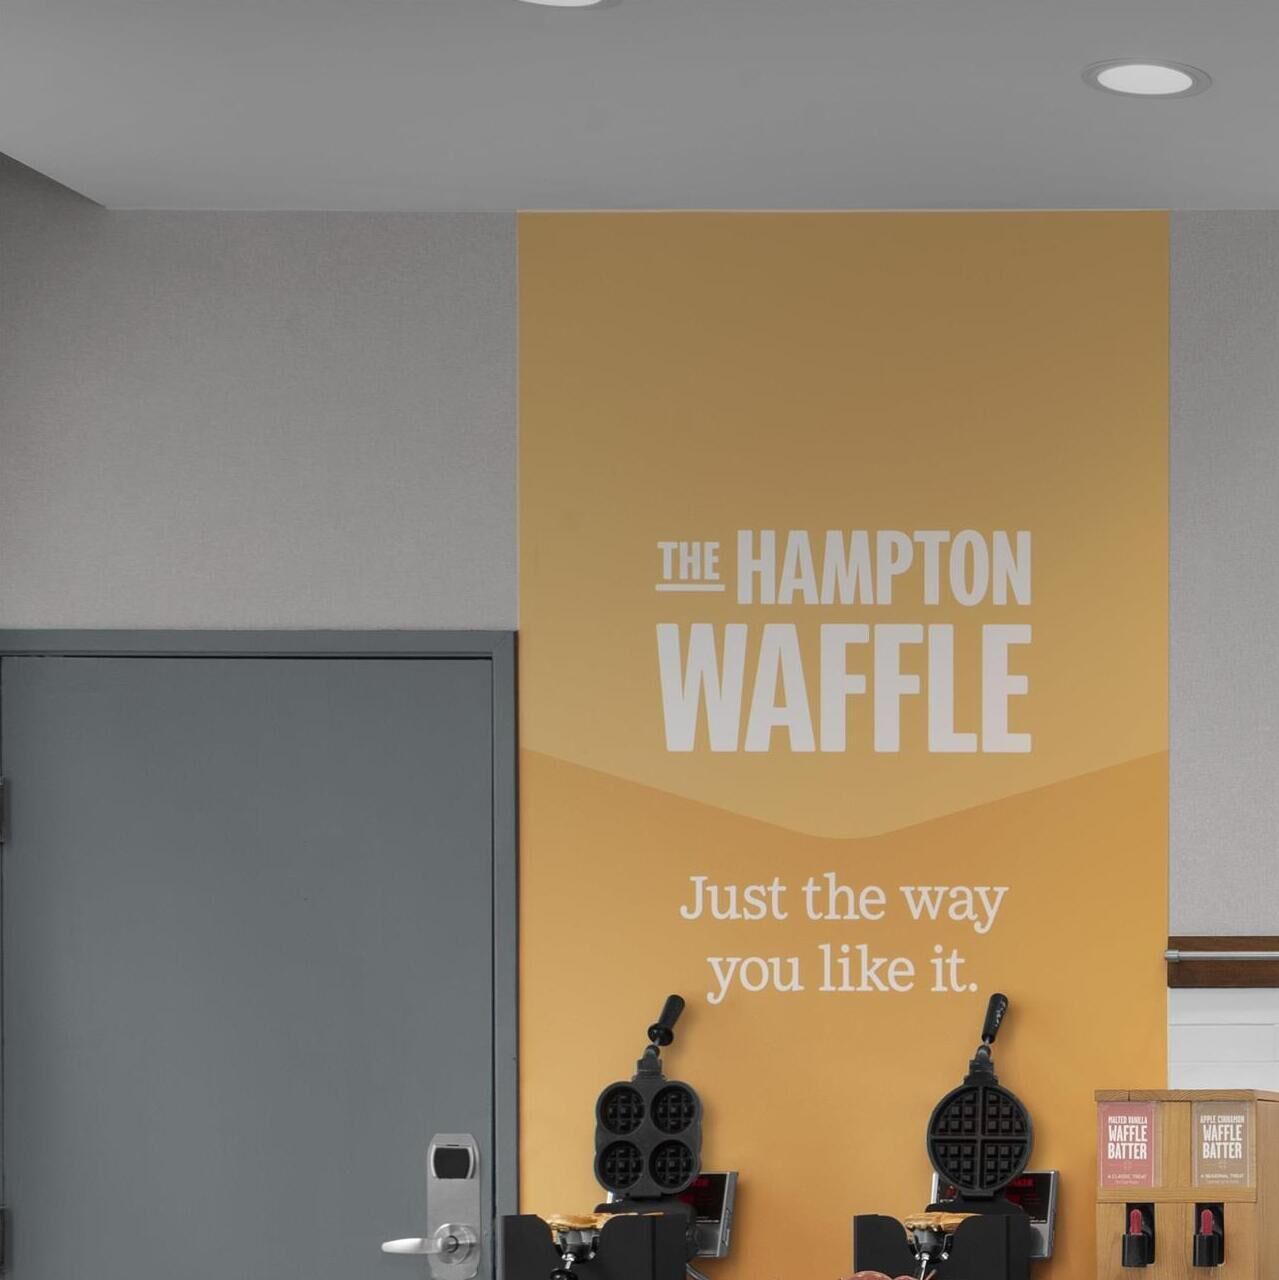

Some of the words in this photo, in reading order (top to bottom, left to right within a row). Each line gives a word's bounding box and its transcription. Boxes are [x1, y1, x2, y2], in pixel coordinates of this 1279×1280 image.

[657, 541, 720, 580] THE
[737, 529, 1032, 606] HAMPTON
[656, 622, 1032, 753] WAFFLE
[680, 875, 788, 921] Just
[801, 871, 887, 921] the
[900, 885, 1009, 934] way
[706, 954, 804, 1005] you
[818, 943, 915, 993] like
[930, 946, 979, 993] it.
[1108, 1115, 1128, 1124] MALTED
[1128, 1115, 1148, 1124] VANILLA
[1200, 1114, 1217, 1124] APPLE
[1217, 1114, 1245, 1124] CINNAMON
[1108, 1125, 1148, 1142] WAFFLE
[1203, 1124, 1243, 1141] WAFFLE
[1107, 1142, 1148, 1160] BATTER
[1202, 1142, 1242, 1159] BATTER
